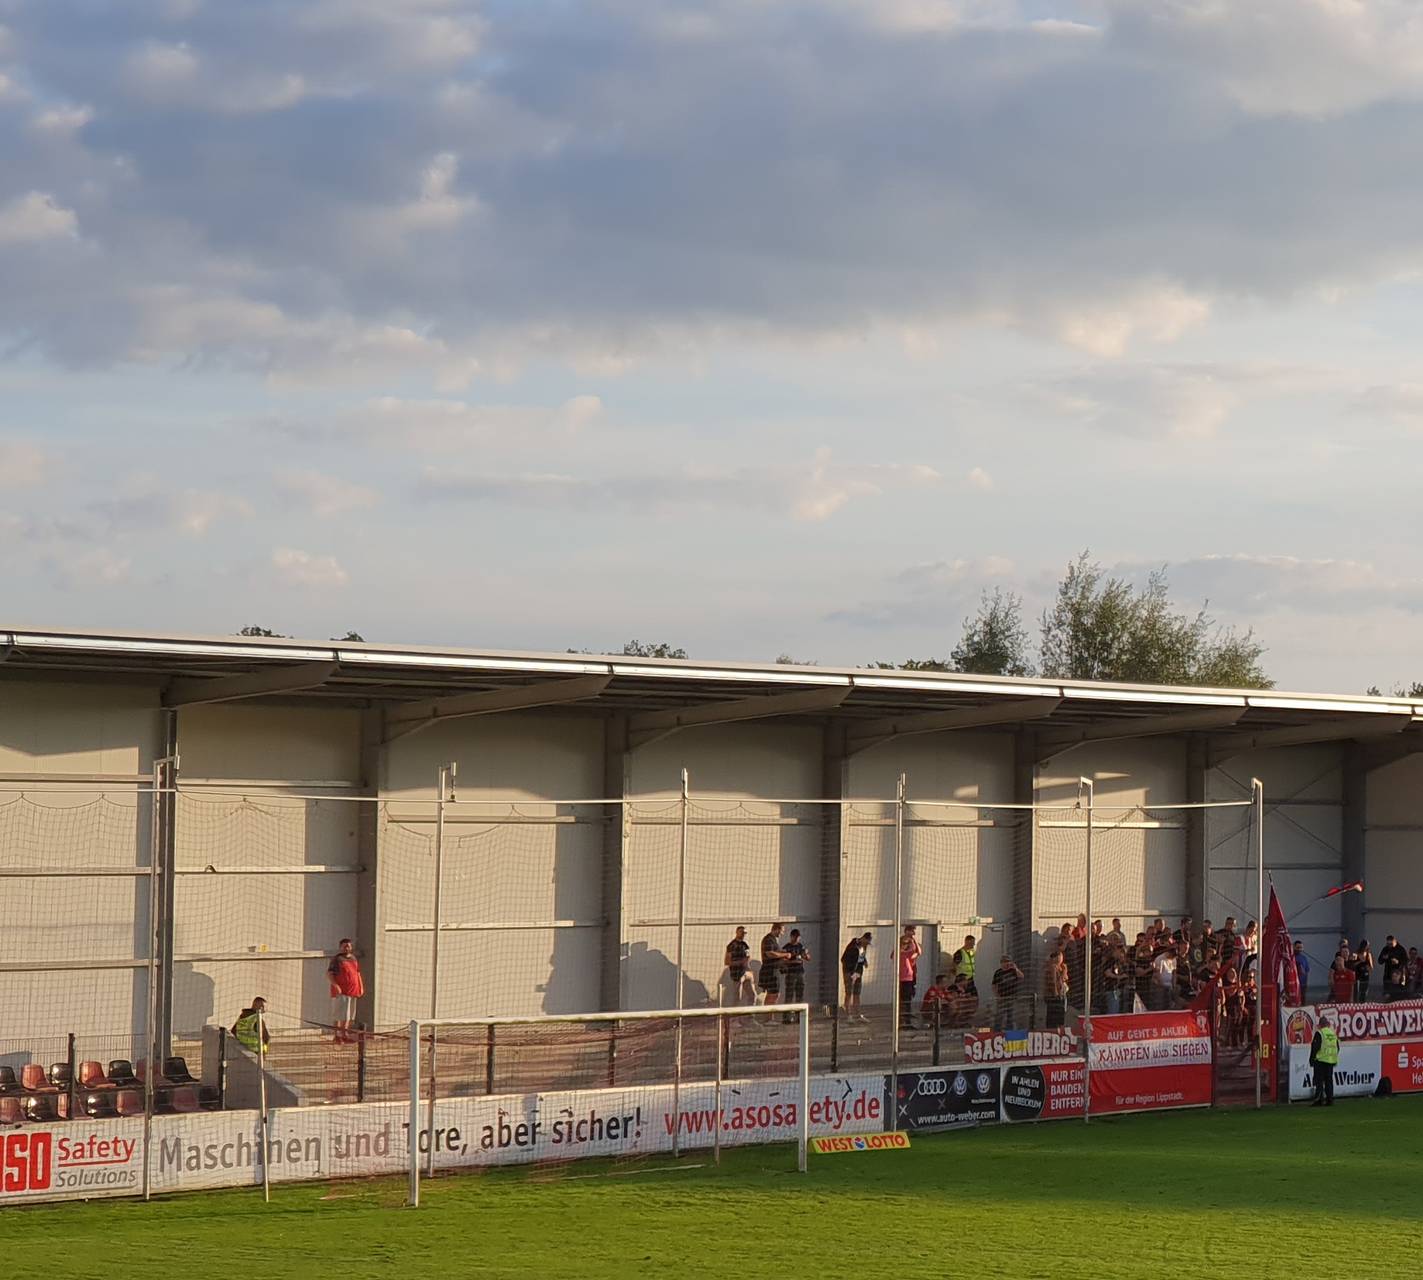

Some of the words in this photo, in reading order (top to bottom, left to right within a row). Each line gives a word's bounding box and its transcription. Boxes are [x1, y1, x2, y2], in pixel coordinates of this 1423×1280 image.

[1107, 1029, 1125, 1041] AUF
[1160, 1025, 1188, 1037] AHLEN
[1099, 1045, 1150, 1063] KÄMPFEN
[1172, 1042, 1209, 1057] SIEGEN
[1011, 1075, 1019, 1085] IN
[1019, 1076, 1040, 1089] AHLEN
[1051, 1070, 1069, 1082] NUR
[1334, 1070, 1375, 1086] Weber
[1017, 1087, 1031, 1097] UND
[1135, 1094, 1155, 1105] Region
[1004, 1094, 1042, 1109] NEUBECKUM
[664, 1089, 881, 1136] www.asosaety.de
[917, 1109, 996, 1125] www.auto-weber.com
[159, 1130, 321, 1173] Maschinen
[333, 1122, 391, 1160] und
[480, 1114, 542, 1150] aber
[551, 1106, 642, 1145] sicher!
[57, 1134, 136, 1163] Safety
[0, 1132, 51, 1192] SO
[56, 1167, 136, 1188] Solutions
